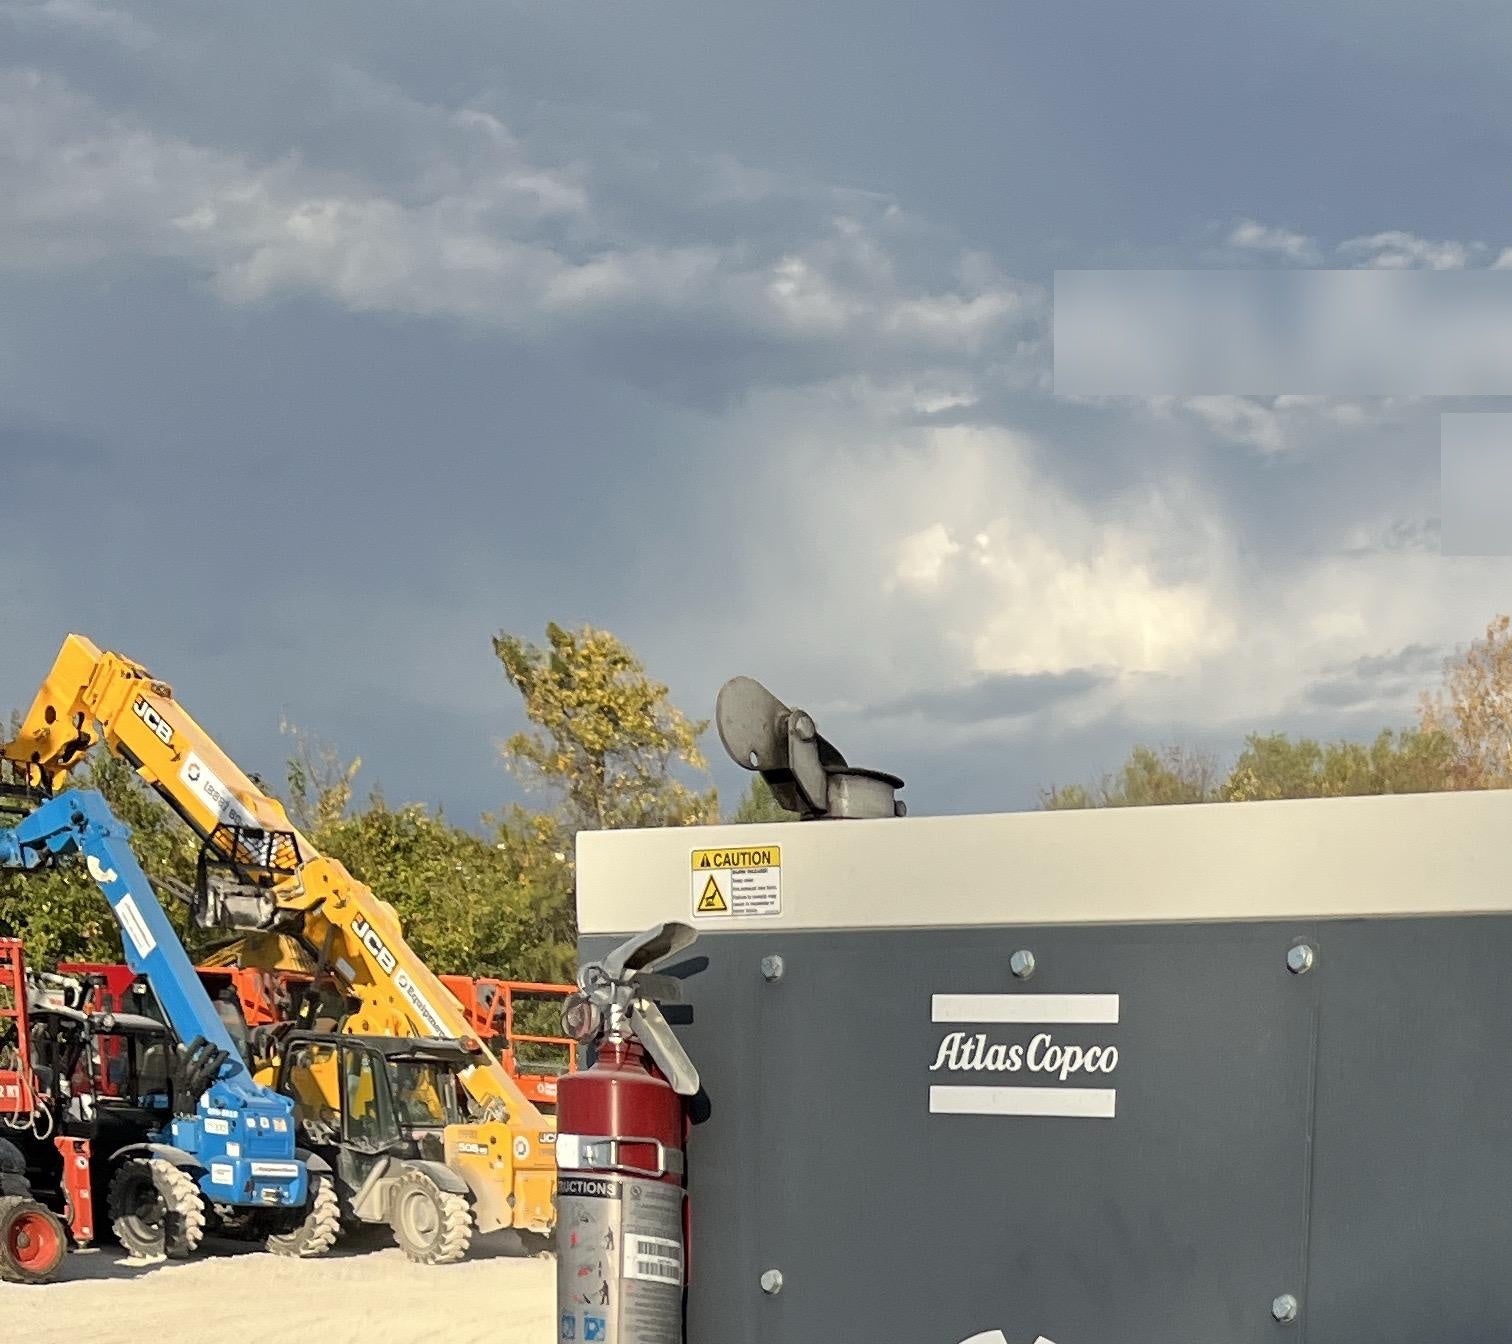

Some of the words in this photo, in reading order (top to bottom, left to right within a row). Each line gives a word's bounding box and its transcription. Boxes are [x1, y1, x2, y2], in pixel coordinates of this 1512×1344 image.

[133, 696, 174, 745] JCB
[713, 851, 771, 867] CAUTION
[351, 913, 398, 976] JCB
[929, 1031, 1024, 1071] Atlas
[1026, 1033, 1119, 1081] Copco
[539, 1133, 556, 1144] JC
